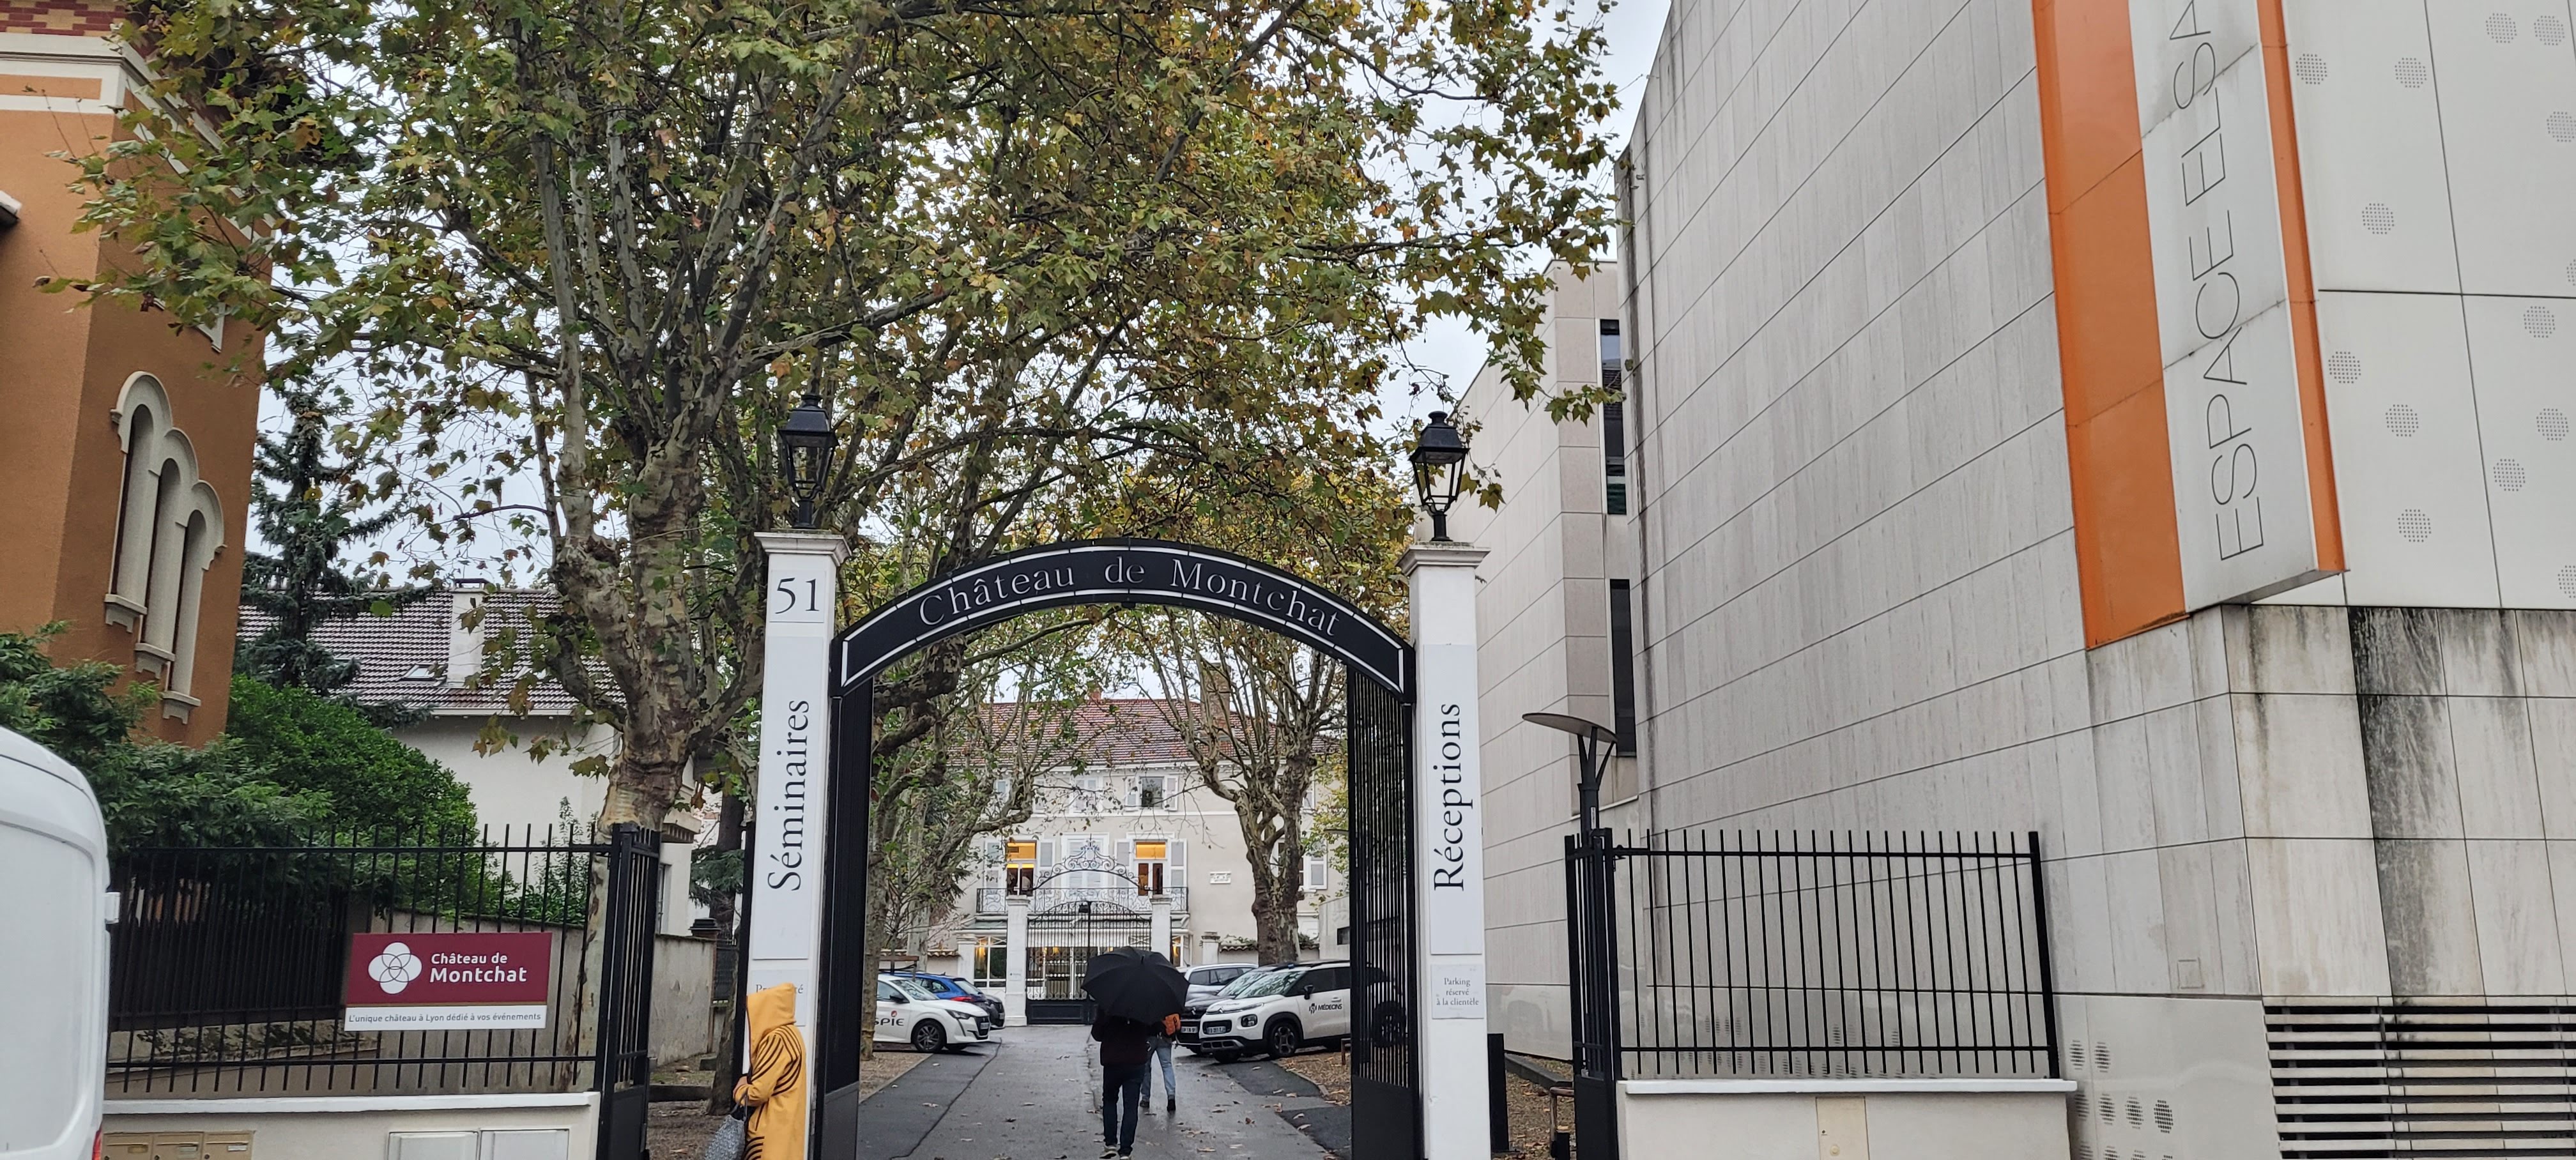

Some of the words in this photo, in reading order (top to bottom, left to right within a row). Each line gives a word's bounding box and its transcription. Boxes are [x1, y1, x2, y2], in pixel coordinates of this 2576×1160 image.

[2169, 0, 2225, 206] ELSA
[2189, 210, 2264, 561] ESPACE
[775, 577, 820, 614] 51
[919, 567, 1075, 625] Château
[1105, 556, 1145, 584] de
[1170, 559, 1340, 636] Montchat
[767, 700, 809, 890] Séminaires
[1433, 704, 1473, 891] Réceptions
[430, 966, 527, 983] Montchat
[431, 952, 487, 965] Château
[491, 952, 508, 964] de
[1444, 977, 1471, 987] Parking
[385, 1014, 417, 1022] château
[425, 1014, 444, 1023] Lyon
[446, 1013, 468, 1021] dédié
[493, 1012, 541, 1021] événements
